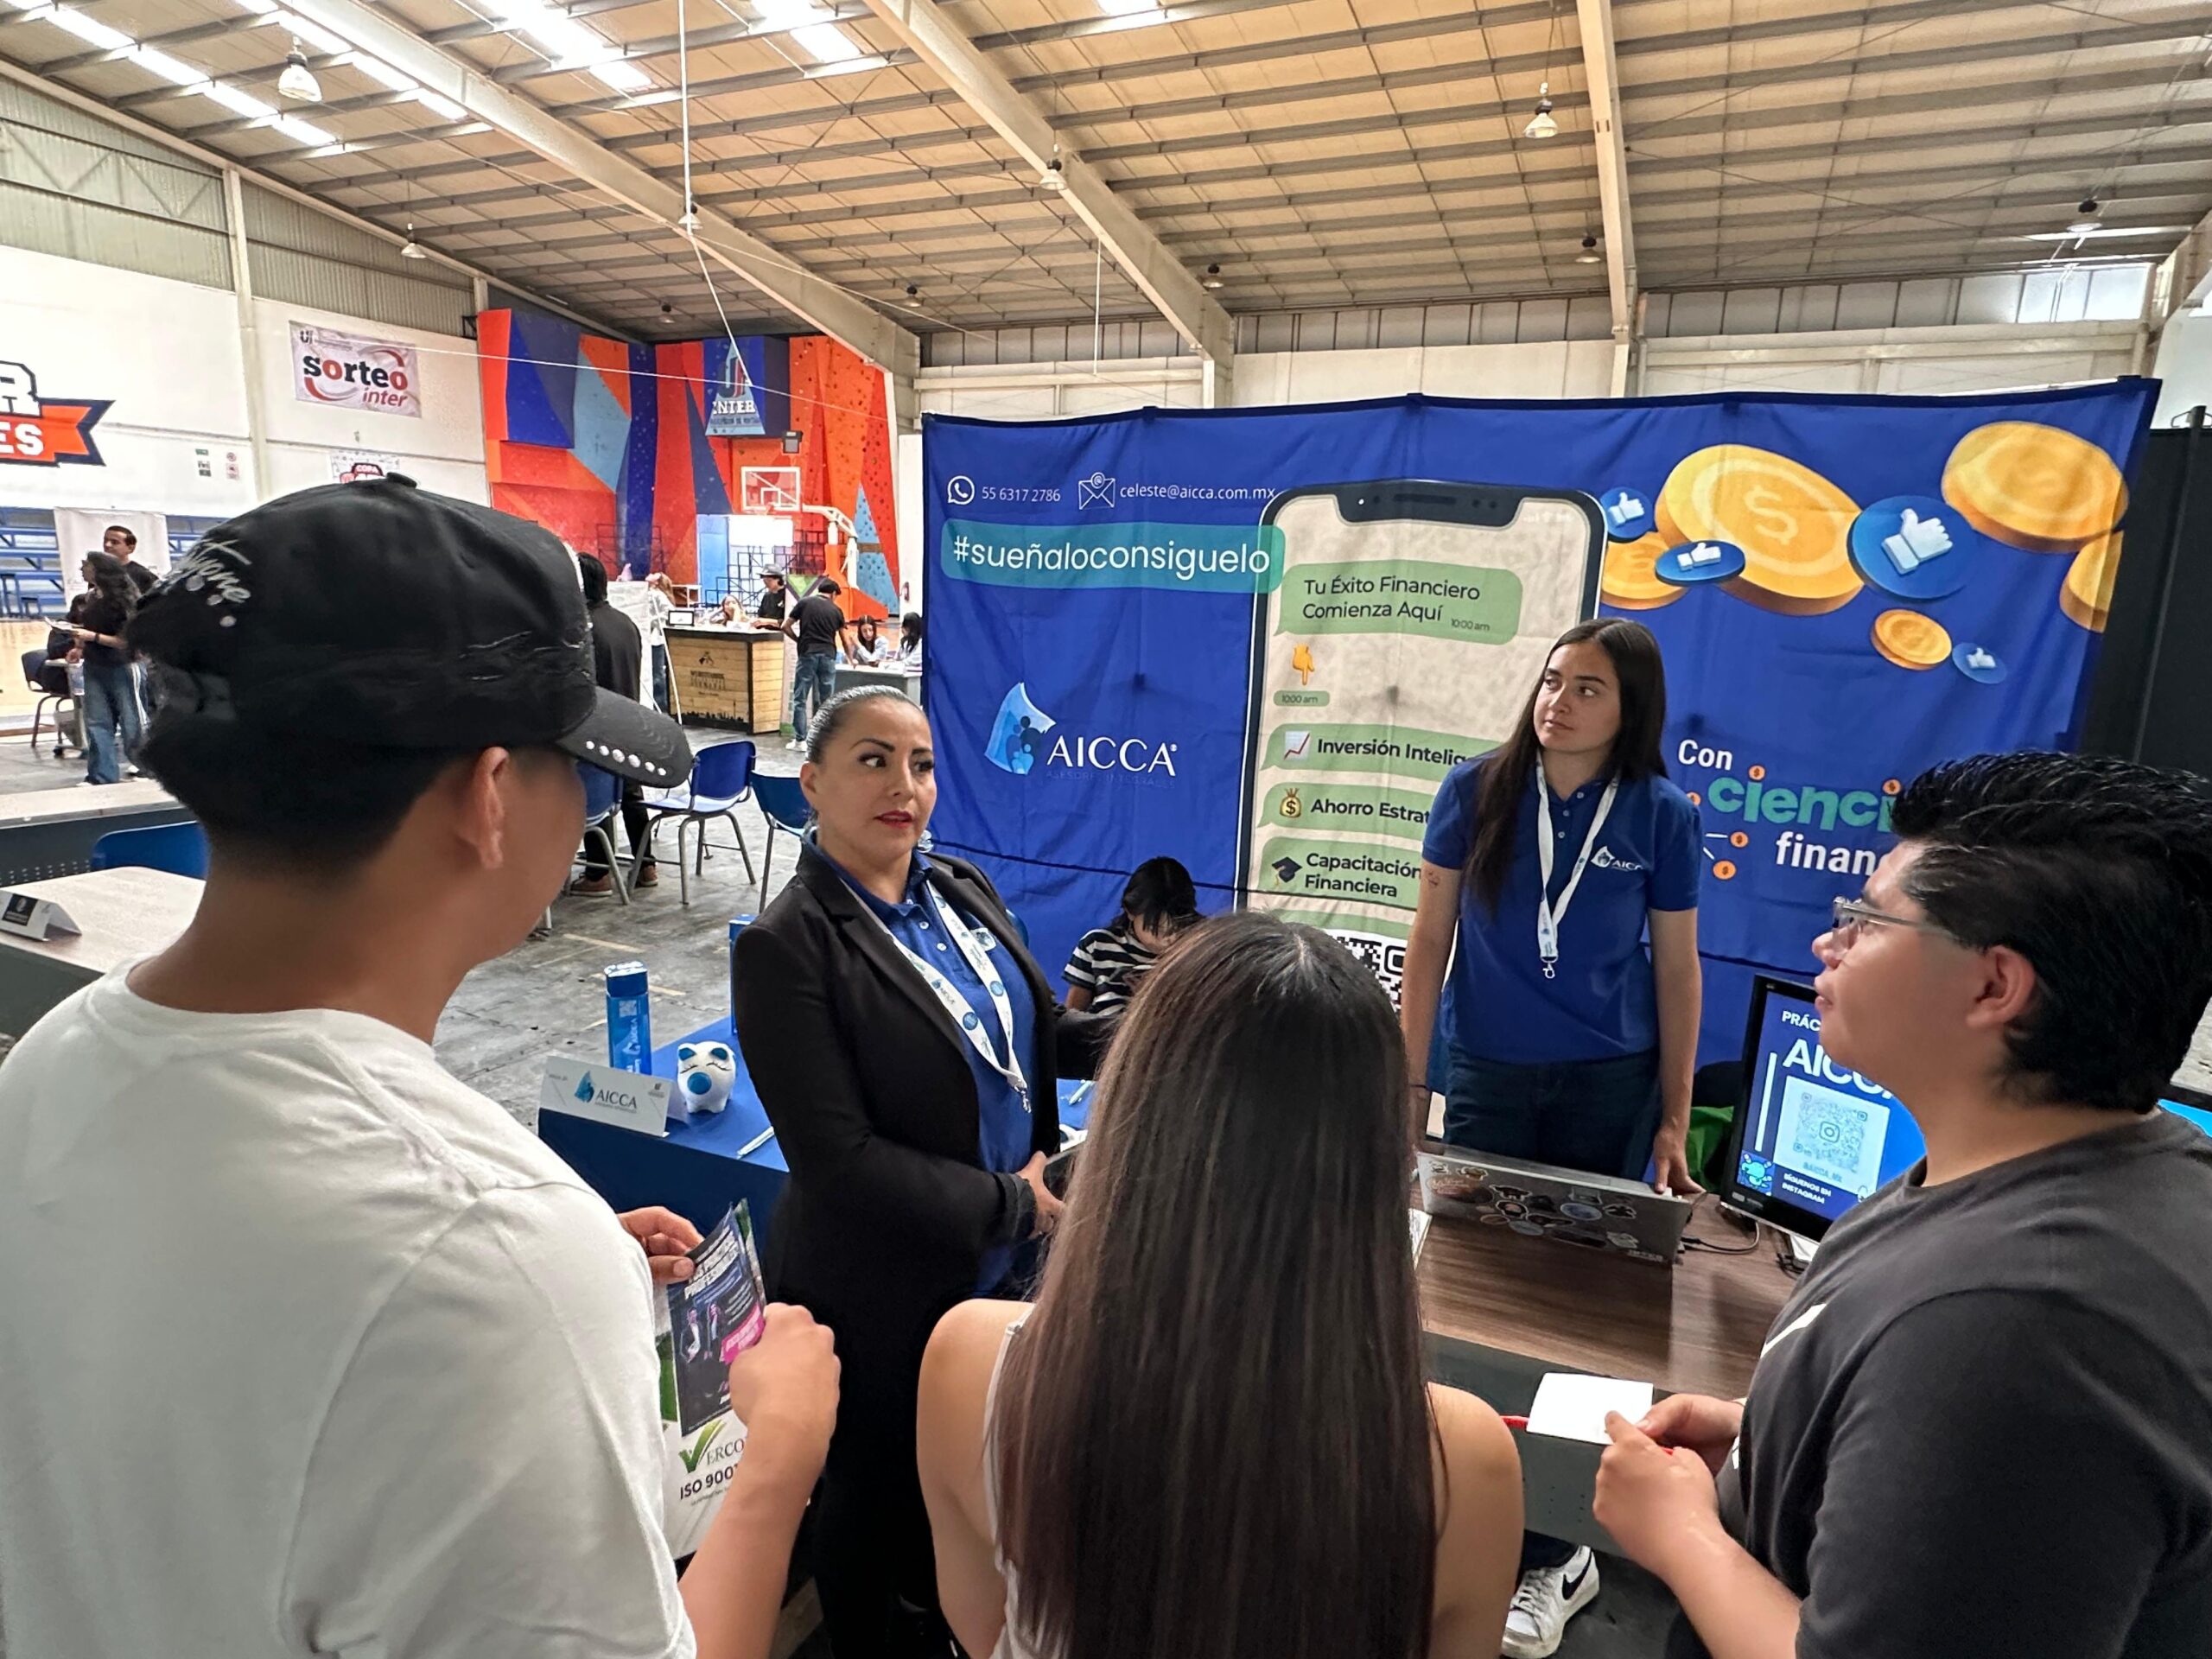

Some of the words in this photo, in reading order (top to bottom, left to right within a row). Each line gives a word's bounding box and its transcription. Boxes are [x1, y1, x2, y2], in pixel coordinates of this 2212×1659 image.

[303, 356, 408, 391] sorteo
[362, 386, 408, 407] inter
[982, 487, 995, 499] 55
[999, 488, 1028, 502] 6317
[1031, 489, 1060, 502] 2786
[1120, 484, 1275, 500] celeste@aicca.com.mx
[953, 536, 1270, 581] #sueñaloconsiguelo
[1304, 579, 1326, 594] Tu
[1331, 575, 1375, 594] Éxito
[1380, 575, 1480, 601] Financiero
[1302, 603, 1392, 619] Comienza
[1397, 602, 1443, 622] Aquí
[1317, 739, 1401, 757] Inversión
[1678, 739, 1732, 771] Con
[1310, 798, 1374, 816] Ahorro
[1379, 802, 1430, 824] Estrat
[1707, 766, 1897, 832] cienci
[1306, 852, 1421, 880] Capacitación
[1776, 830, 1878, 876] finan
[1305, 874, 1398, 898] Financiera
[1782, 1010, 1822, 1032] PRÁC
[595, 1089, 638, 1109] AICCA
[680, 1479, 702, 1501] ISO
[705, 1463, 739, 1488] 900
